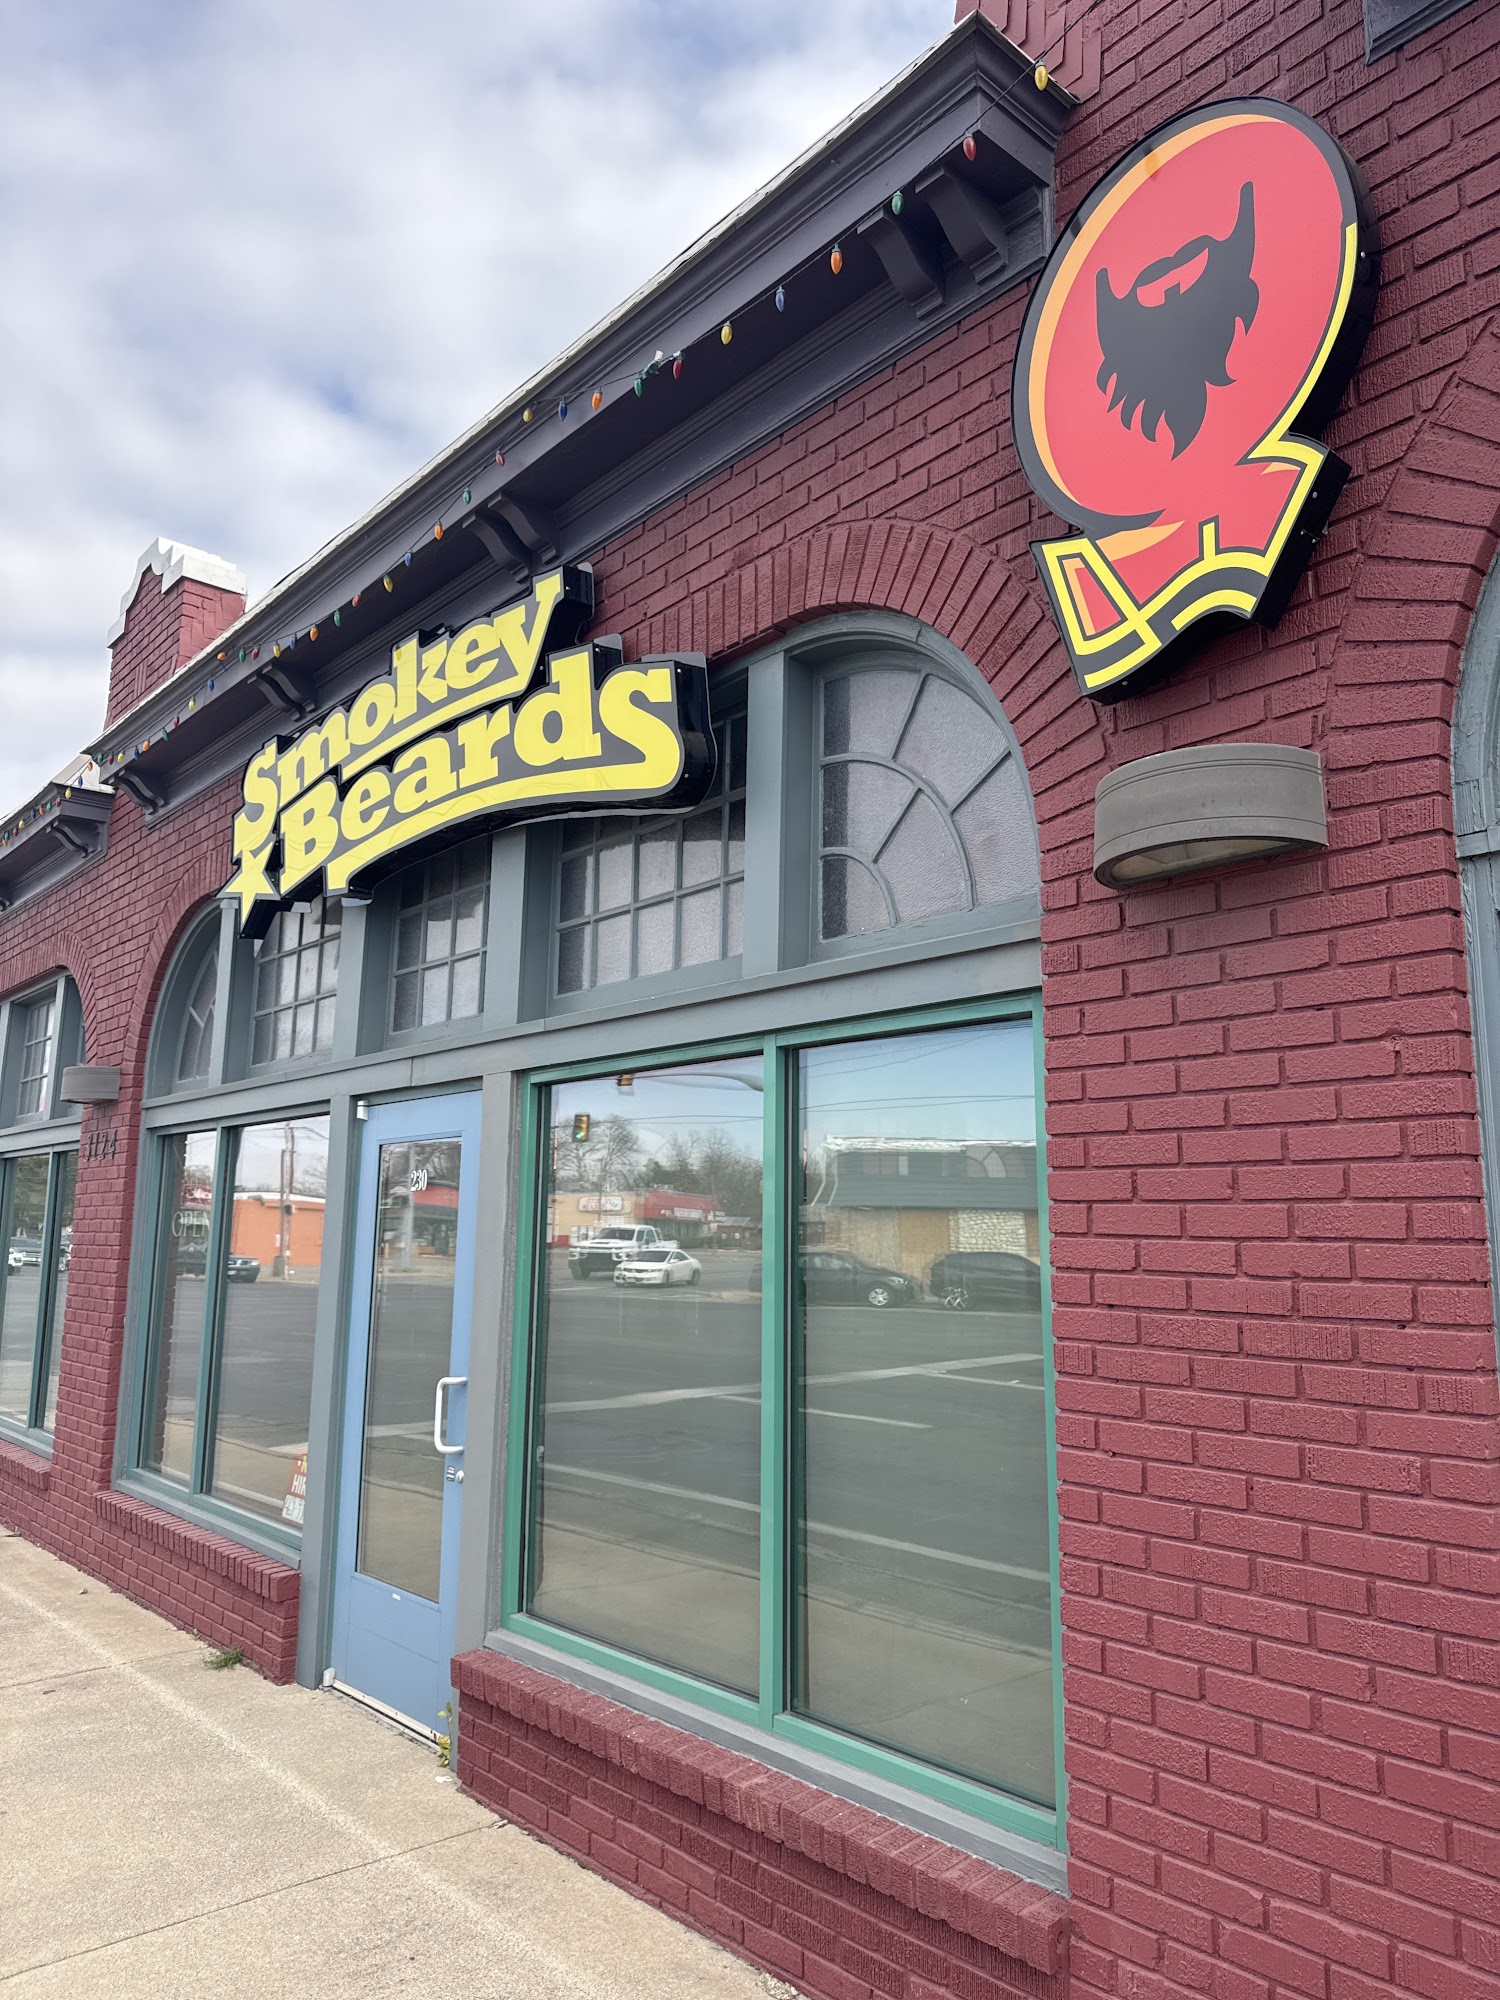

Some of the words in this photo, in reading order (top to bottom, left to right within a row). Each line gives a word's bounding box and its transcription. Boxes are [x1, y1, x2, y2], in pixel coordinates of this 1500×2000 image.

[232, 573, 563, 855] Smokey
[279, 650, 682, 896] Beards
[410, 1169, 428, 1192] 230
